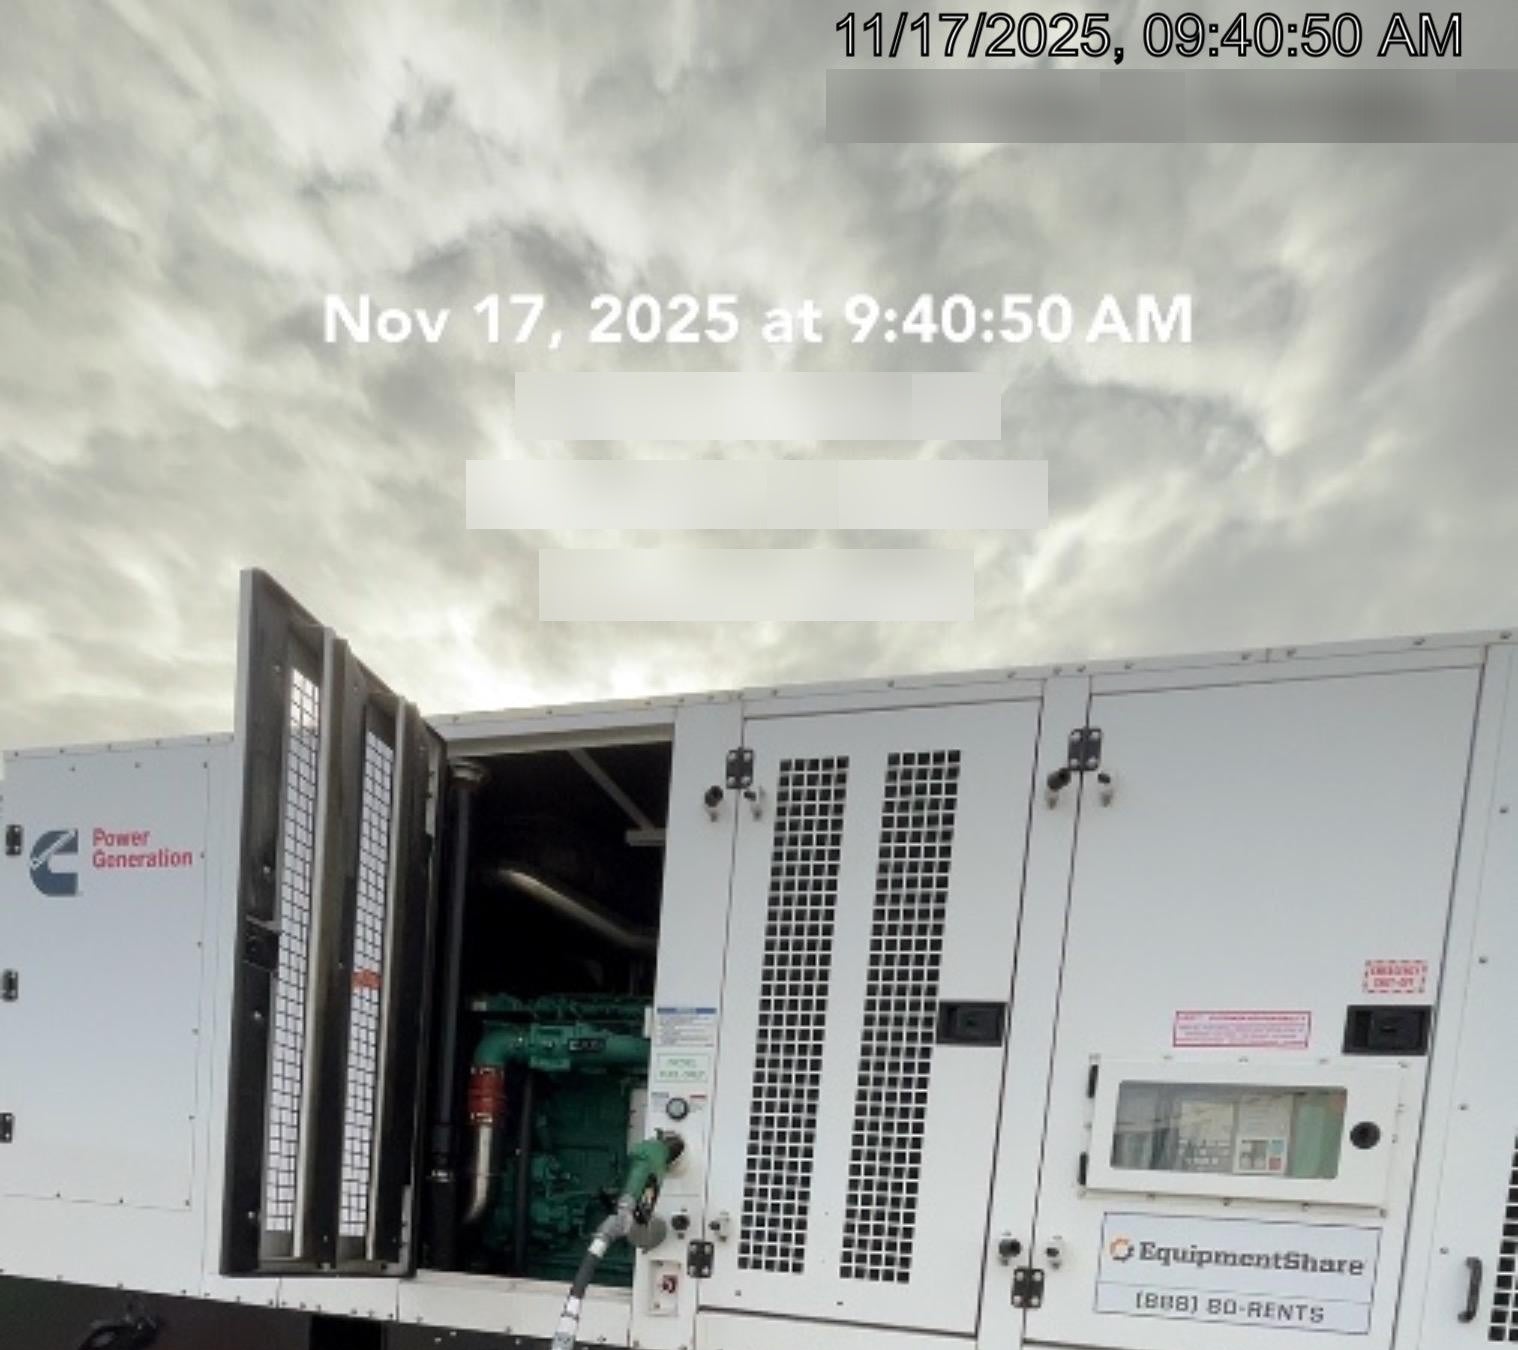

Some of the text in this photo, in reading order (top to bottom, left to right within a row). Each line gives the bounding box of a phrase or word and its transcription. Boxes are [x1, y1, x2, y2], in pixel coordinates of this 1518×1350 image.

[92, 828, 151, 847] Power
[92, 849, 193, 869] Generation
[1138, 1240, 1366, 1276] EquipmentShare
